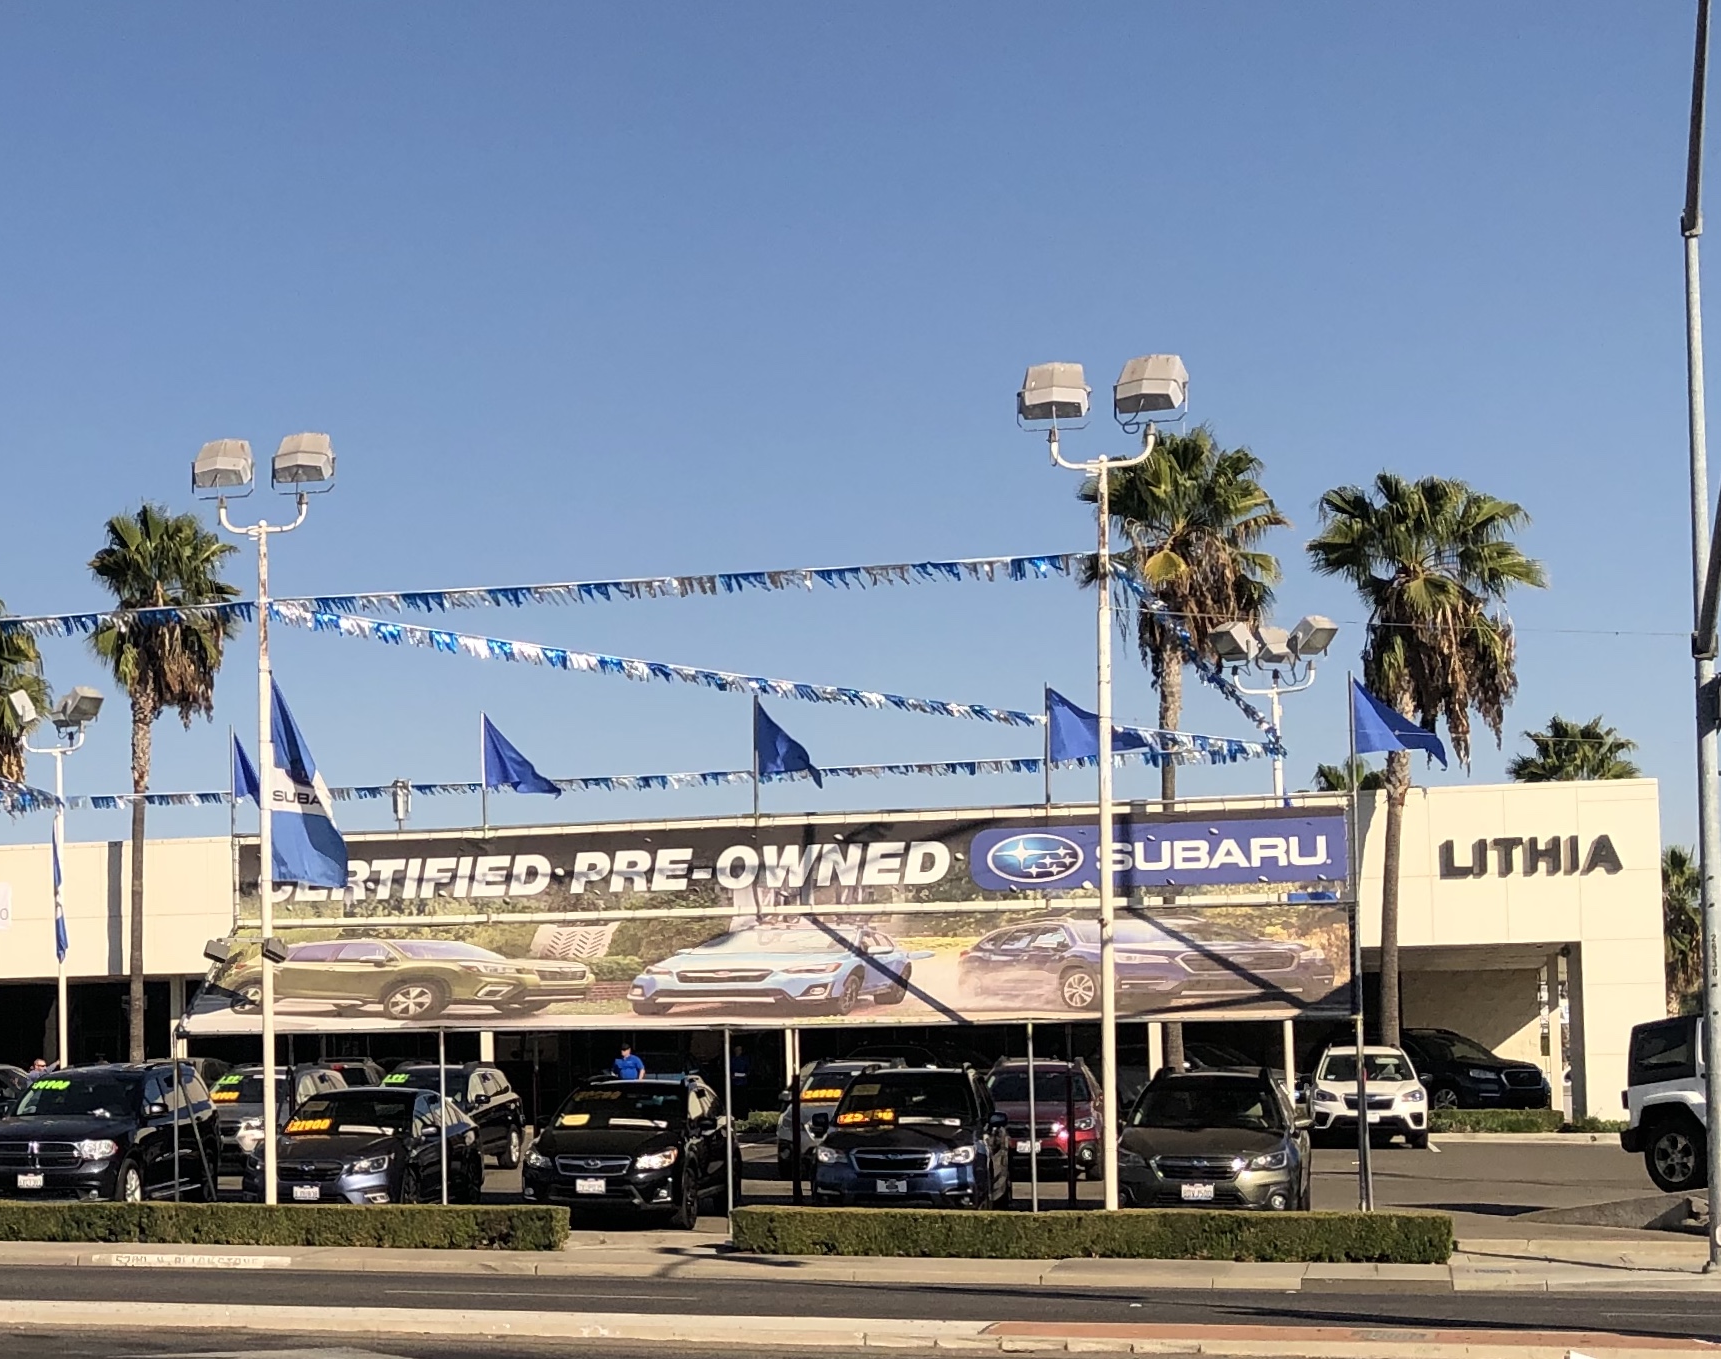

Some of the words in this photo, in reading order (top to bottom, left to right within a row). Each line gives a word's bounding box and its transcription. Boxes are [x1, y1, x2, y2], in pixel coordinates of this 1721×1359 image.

[570, 841, 951, 894] PRE-OWNED
[1096, 835, 1327, 872] SUBARU
[1439, 834, 1623, 880] LITHIA
